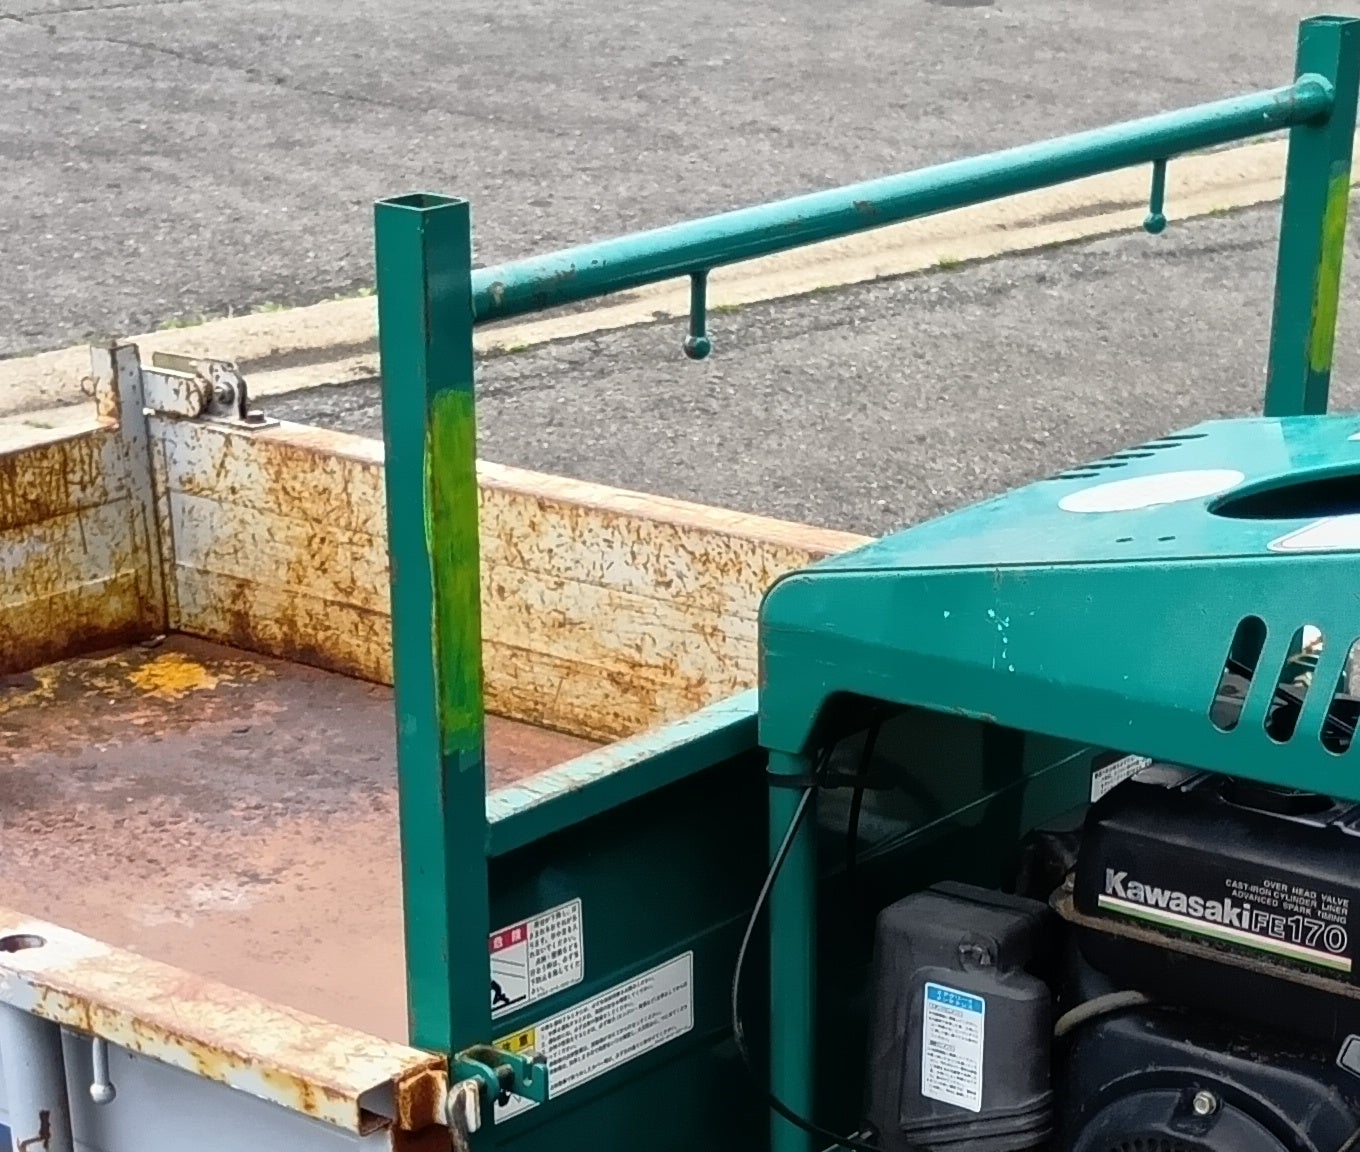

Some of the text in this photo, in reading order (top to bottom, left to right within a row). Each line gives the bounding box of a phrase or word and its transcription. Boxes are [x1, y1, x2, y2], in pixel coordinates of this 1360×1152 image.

[1231, 889, 1347, 925] ADVANCED SPARK TIMING
[1263, 880, 1350, 908] OVER HEAD VALVE
[1273, 889, 1318, 908] CYLINDER
[1322, 902, 1349, 916] LINER
[1105, 867, 1348, 954] Kawasaki FE170
